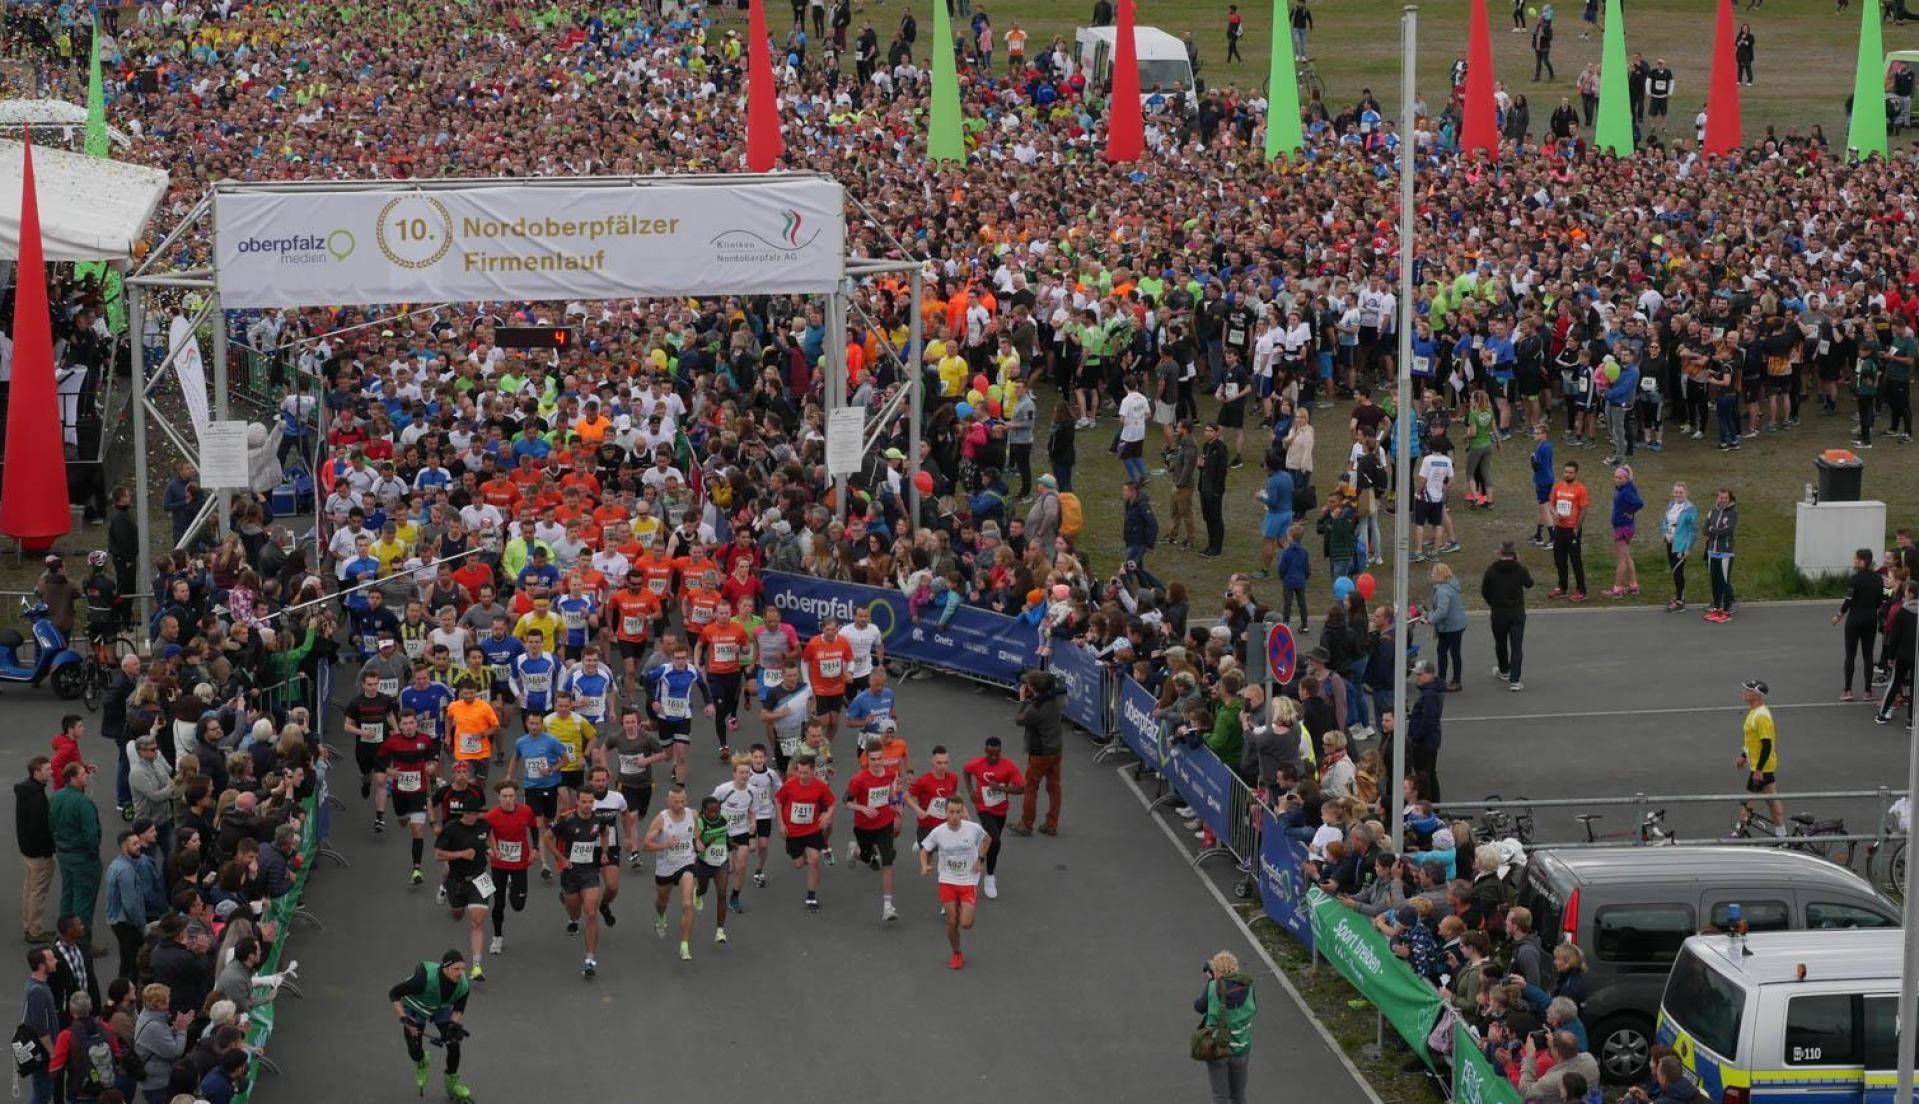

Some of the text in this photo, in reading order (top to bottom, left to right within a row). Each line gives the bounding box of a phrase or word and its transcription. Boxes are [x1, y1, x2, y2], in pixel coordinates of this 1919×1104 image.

[395, 218, 436, 242] 10.
[463, 214, 680, 241] Nordoberpfälzer
[238, 234, 326, 257] oberpfalz
[717, 240, 756, 250] Kliniken
[281, 252, 327, 265] medien
[464, 250, 606, 273] Firmenlauf
[554, 331, 564, 345] 4
[774, 589, 854, 622] oberpfal
[1803, 1047, 1822, 1060] 110
